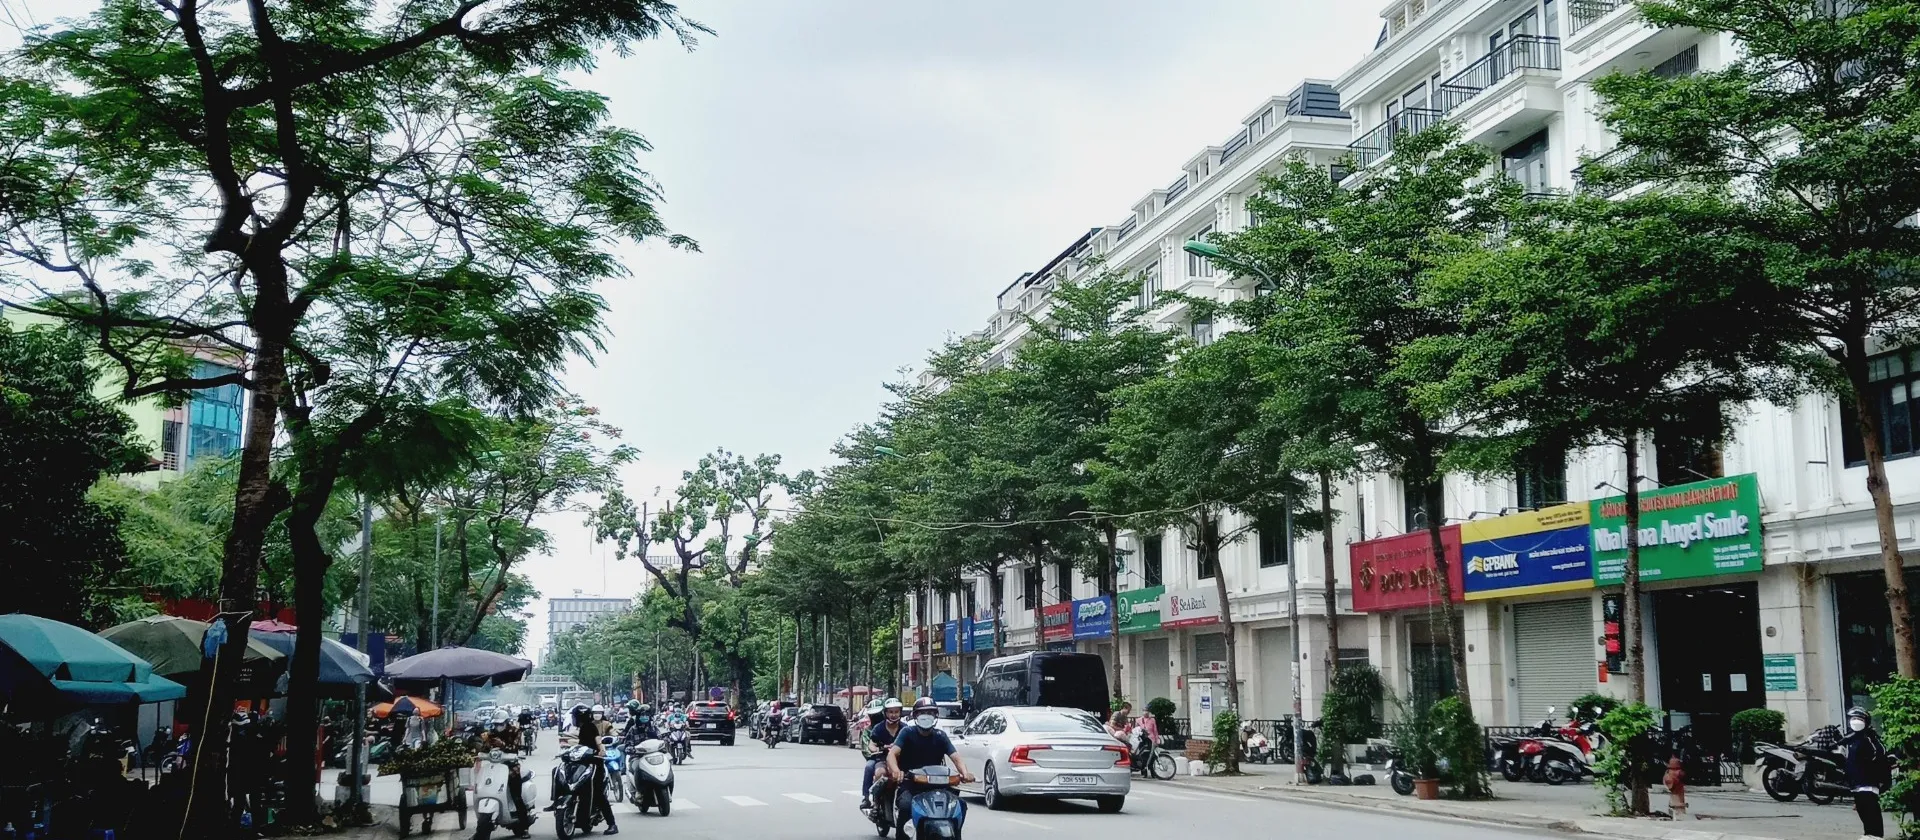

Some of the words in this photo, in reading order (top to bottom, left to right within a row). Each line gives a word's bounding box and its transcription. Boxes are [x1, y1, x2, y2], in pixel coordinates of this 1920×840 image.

[1595, 527, 1620, 551] Nha
[1620, 525, 1658, 548] Koa
[1660, 514, 1703, 549] Angel
[1704, 510, 1750, 538] Smile
[1483, 553, 1519, 572] GPBANK
